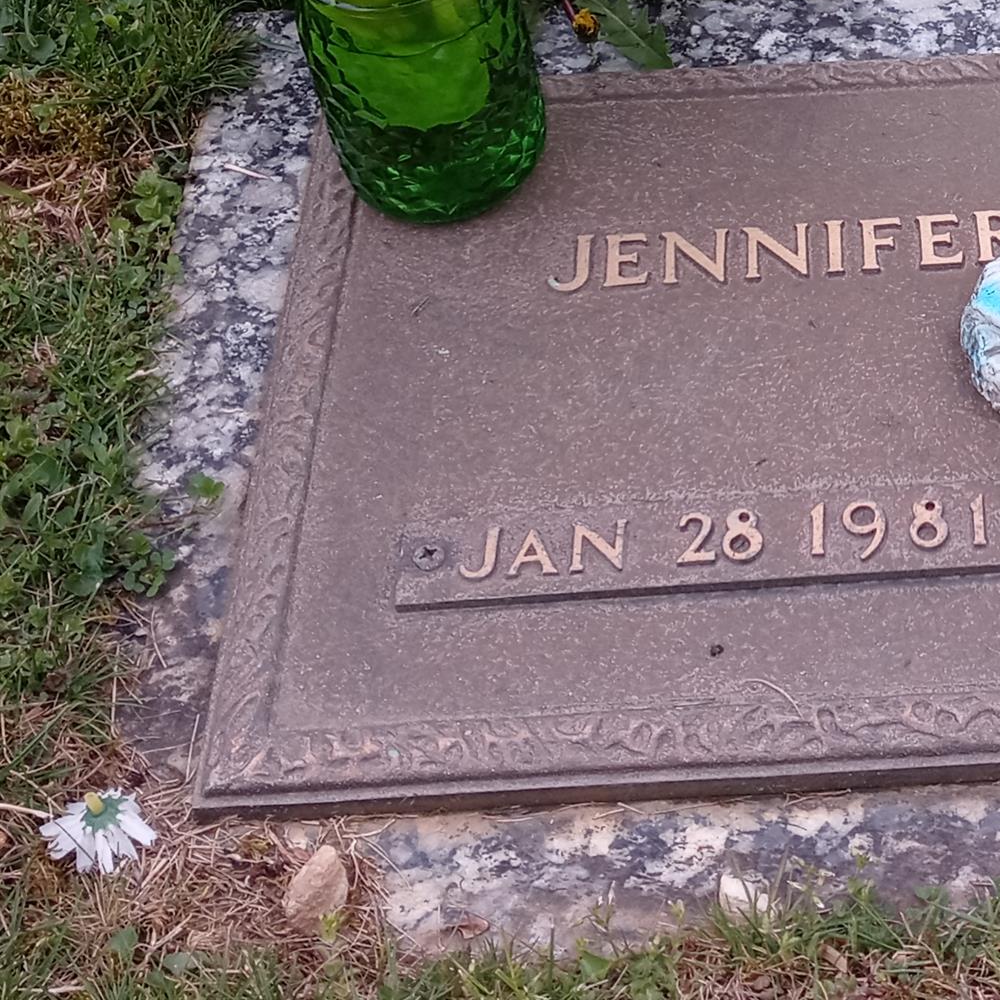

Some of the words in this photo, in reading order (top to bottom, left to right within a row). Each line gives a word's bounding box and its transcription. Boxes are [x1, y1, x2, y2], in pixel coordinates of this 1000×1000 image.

[459, 519, 629, 579] JAN
[677, 508, 764, 565] 28
[808, 493, 988, 560] 1981
